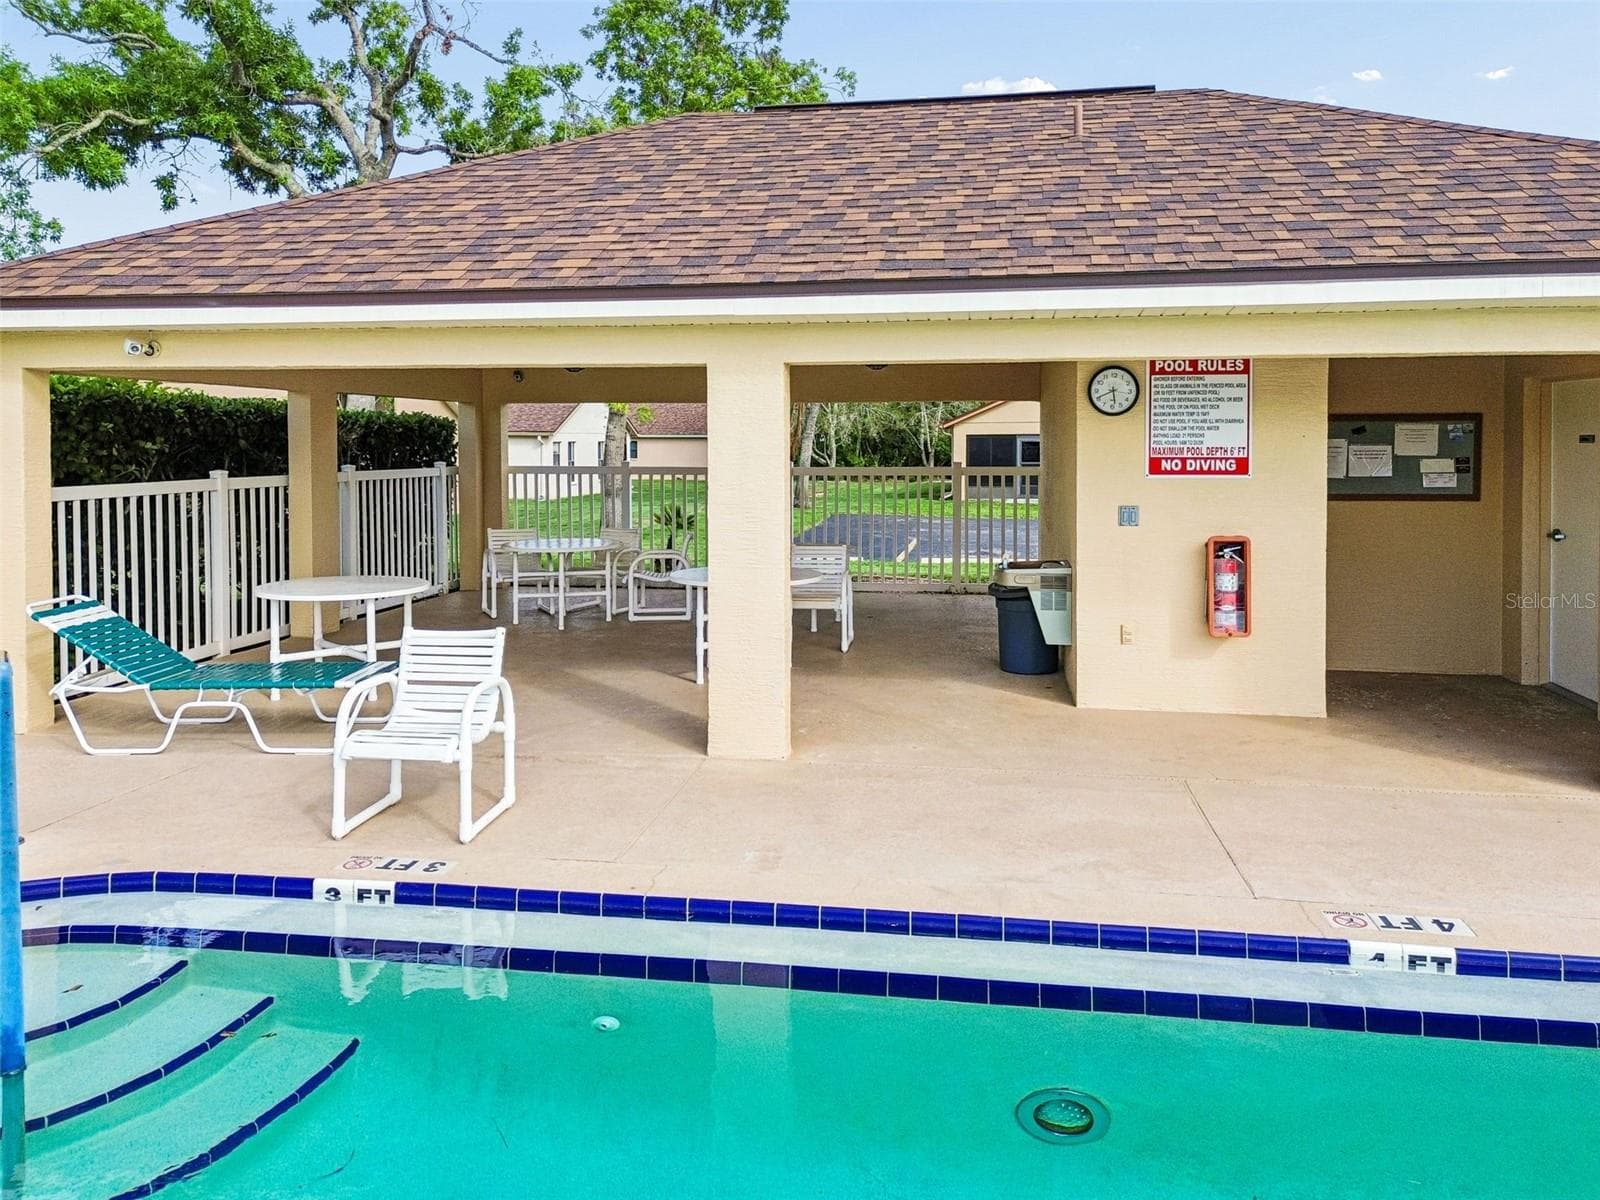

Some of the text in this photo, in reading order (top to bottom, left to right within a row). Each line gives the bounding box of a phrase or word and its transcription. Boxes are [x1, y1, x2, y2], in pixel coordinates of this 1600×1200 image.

[1155, 360, 1244, 372] POOL RULES
[1152, 447, 1184, 456] MAXIMUM
[1186, 447, 1204, 456] POOL
[1206, 447, 1228, 456] DEPTH
[1238, 447, 1246, 456] FT
[1161, 459, 1237, 471] NO DIVING
[375, 858, 446, 872] 3 FT
[324, 887, 391, 904] 3 FT
[1378, 915, 1455, 932] 4 FT
[1408, 954, 1452, 973] FT
